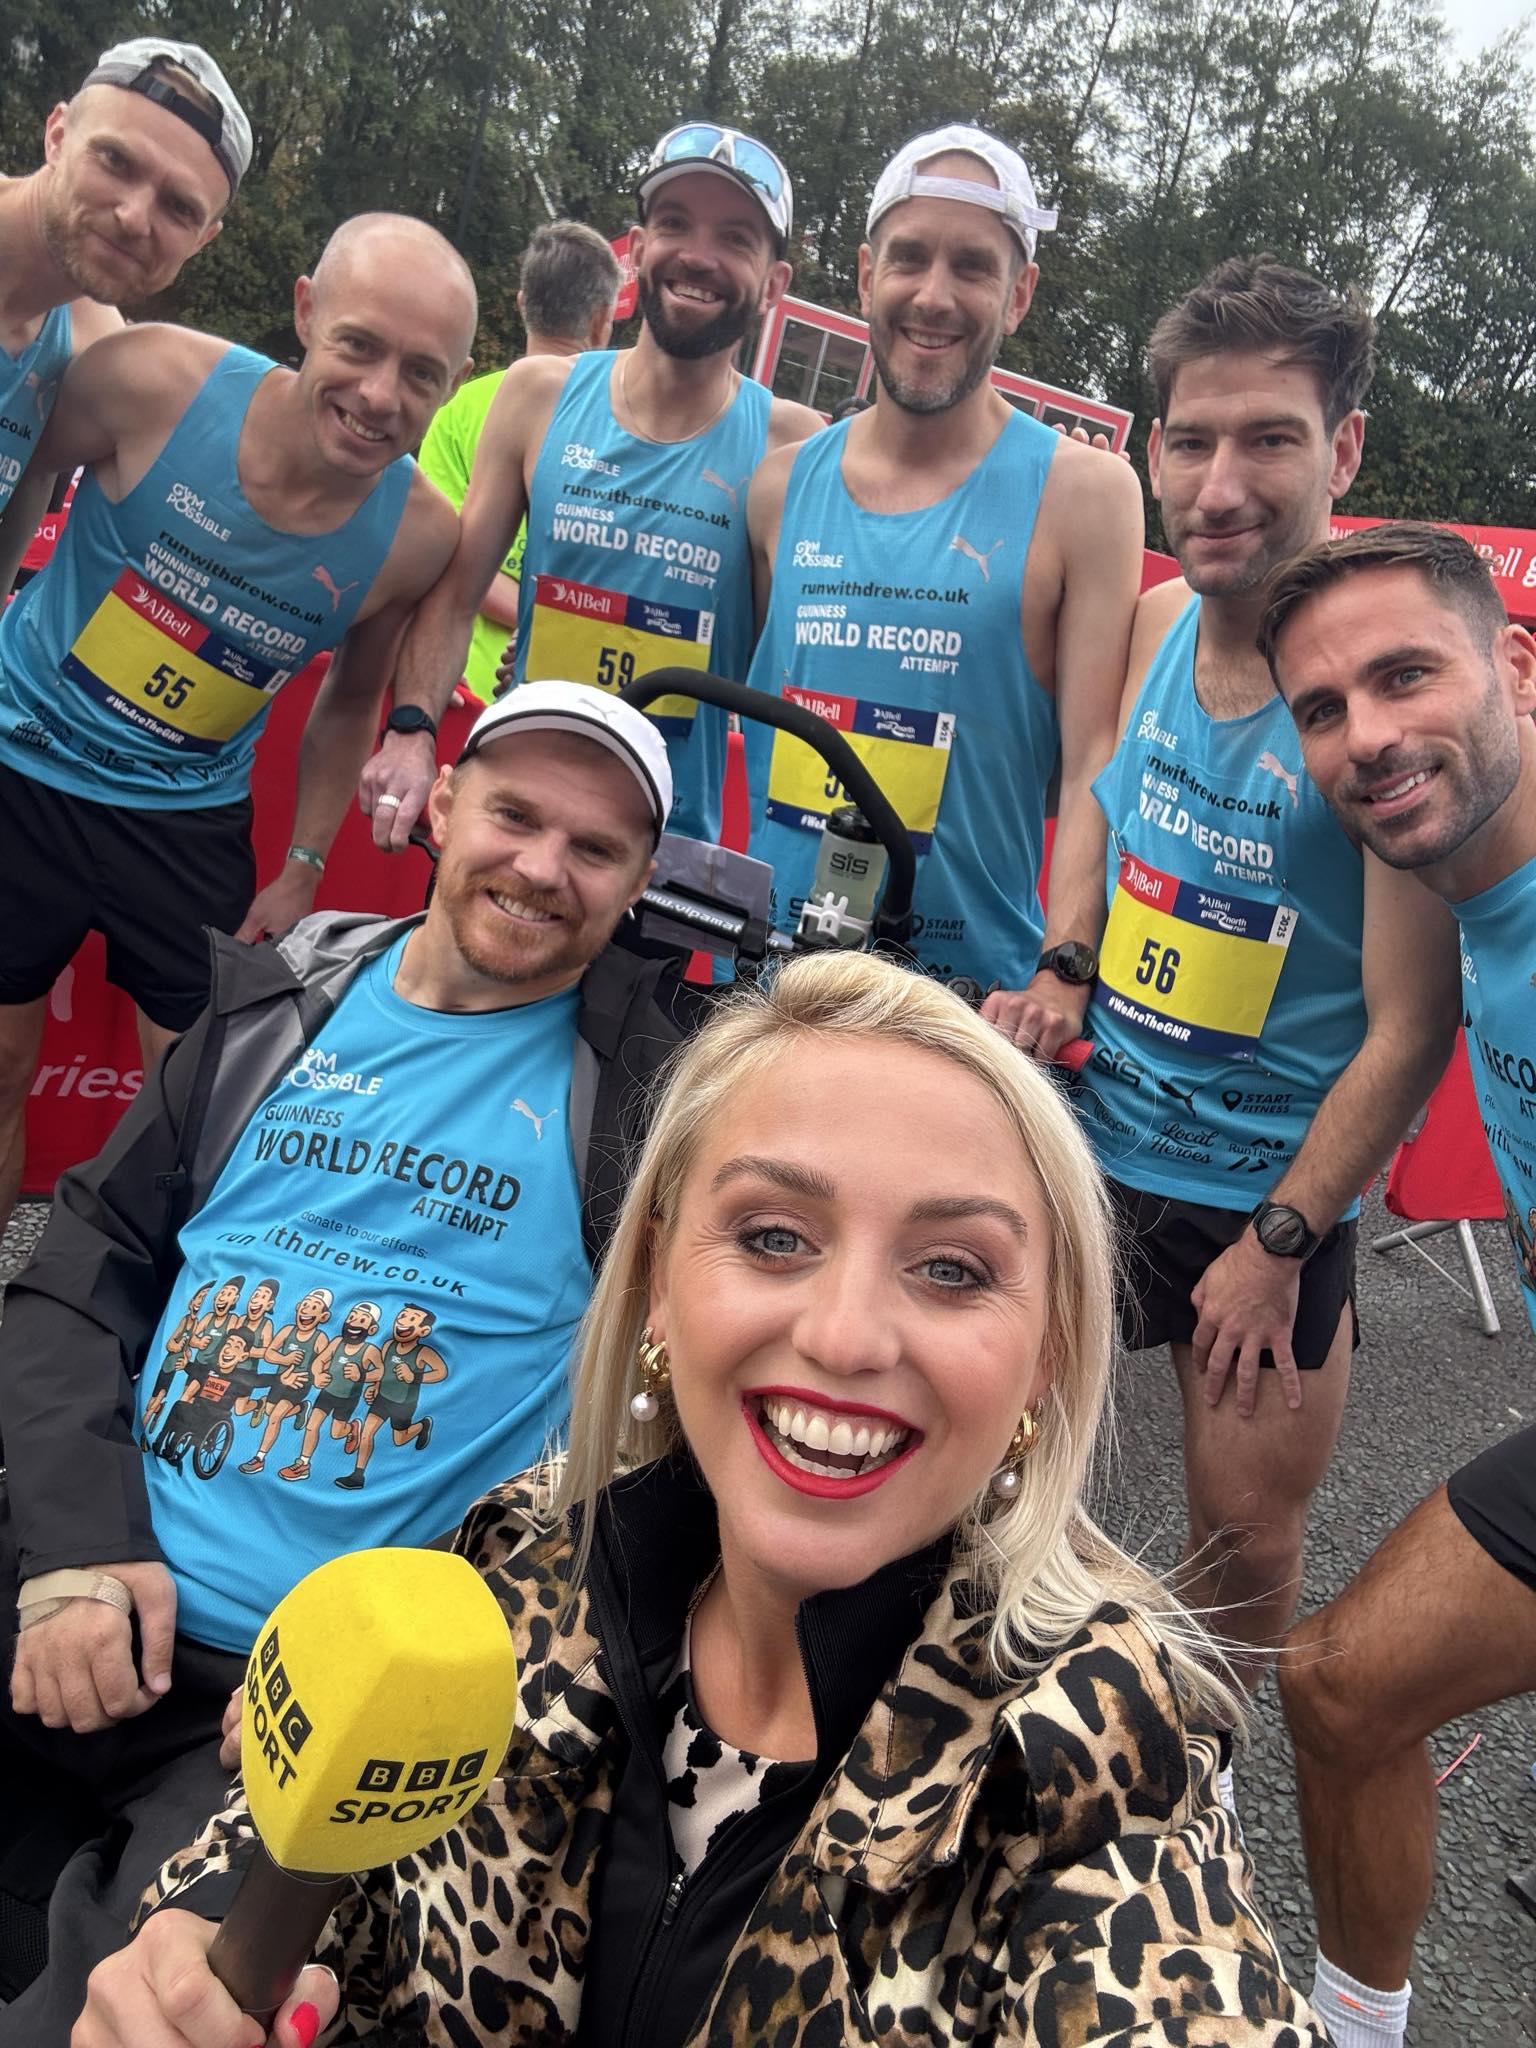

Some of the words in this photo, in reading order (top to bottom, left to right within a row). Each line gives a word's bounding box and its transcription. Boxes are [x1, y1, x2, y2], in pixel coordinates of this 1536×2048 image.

[561, 456, 622, 478] POSSIBLE
[166, 493, 232, 542] POSSIBLE
[555, 502, 614, 523] GUINNESS
[563, 481, 732, 530] runwithdrew.co.uk
[150, 542, 211, 588] GUINNESS
[553, 517, 628, 551] WORLD
[634, 532, 721, 574] RECORD
[792, 553, 844, 569] POSSIBLE
[159, 530, 325, 627] runwithdrew.co.uk
[664, 565, 716, 590] ATTEMPT
[801, 580, 970, 605] runwithdrew.co.uk
[144, 552, 219, 614] WORLD
[220, 605, 307, 654] RECORD
[797, 604, 847, 619] GUINNESS
[795, 622, 861, 648] WORLD
[867, 625, 962, 656] RECORD
[143, 662, 196, 710] 55
[597, 646, 636, 690] 59
[900, 656, 959, 676] ATTEMPT
[106, 694, 185, 745] #WeAreTheGNR
[1213, 859, 1275, 886] ATTEMPT
[927, 918, 966, 930] START
[1200, 909, 1221, 921] great
[1225, 916, 1248, 927] north
[1275, 914, 1291, 939] 2025
[1135, 937, 1181, 995] 56
[1108, 995, 1192, 1043] #WeAreTheGNR
[30, 1054, 143, 1101] ries
[265, 1103, 345, 1128] GUINNESS
[1242, 1104, 1290, 1114] FITNESS
[1245, 1093, 1293, 1104] START
[1150, 1134, 1213, 1164] Heroes
[1160, 1122, 1219, 1147] Local
[254, 1128, 371, 1176] WORLD
[373, 1141, 522, 1212] RECORD
[300, 1209, 344, 1233] donate
[345, 1223, 359, 1238] to
[361, 1230, 380, 1243] our
[381, 1236, 429, 1260] efforts:
[410, 1196, 509, 1242] ATTEMPT
[205, 1380, 227, 1392] DREW
[262, 1630, 312, 1753] BBC
[247, 1656, 298, 1790] SPORT
[360, 1751, 486, 1791] BBC
[329, 1783, 480, 1825] SPORT
